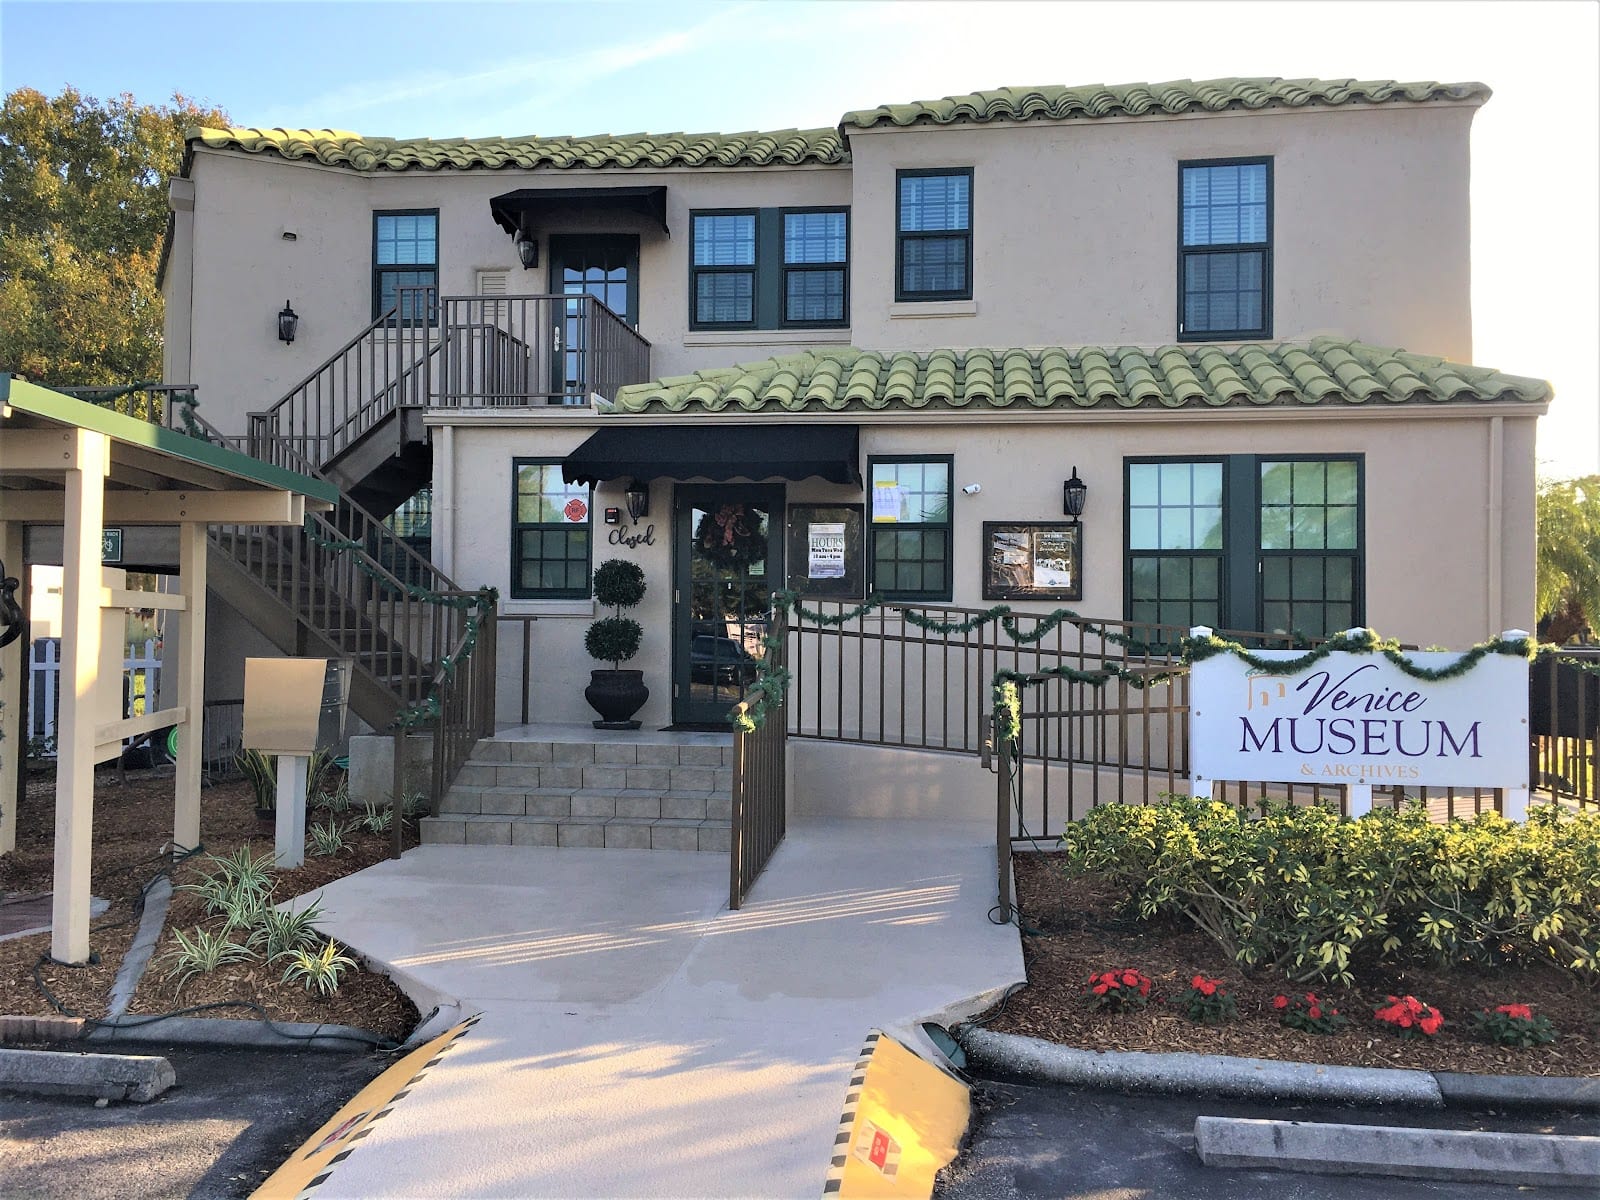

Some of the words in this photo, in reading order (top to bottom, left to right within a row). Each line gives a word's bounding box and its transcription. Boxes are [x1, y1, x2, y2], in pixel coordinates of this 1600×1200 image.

[609, 525, 655, 549] Closed
[812, 538, 843, 547] HOURS
[1296, 664, 1427, 716] Venice
[1238, 716, 1483, 758] MUSEUM
[1300, 763, 1315, 776] &
[1321, 763, 1419, 779] ARCHIVES
